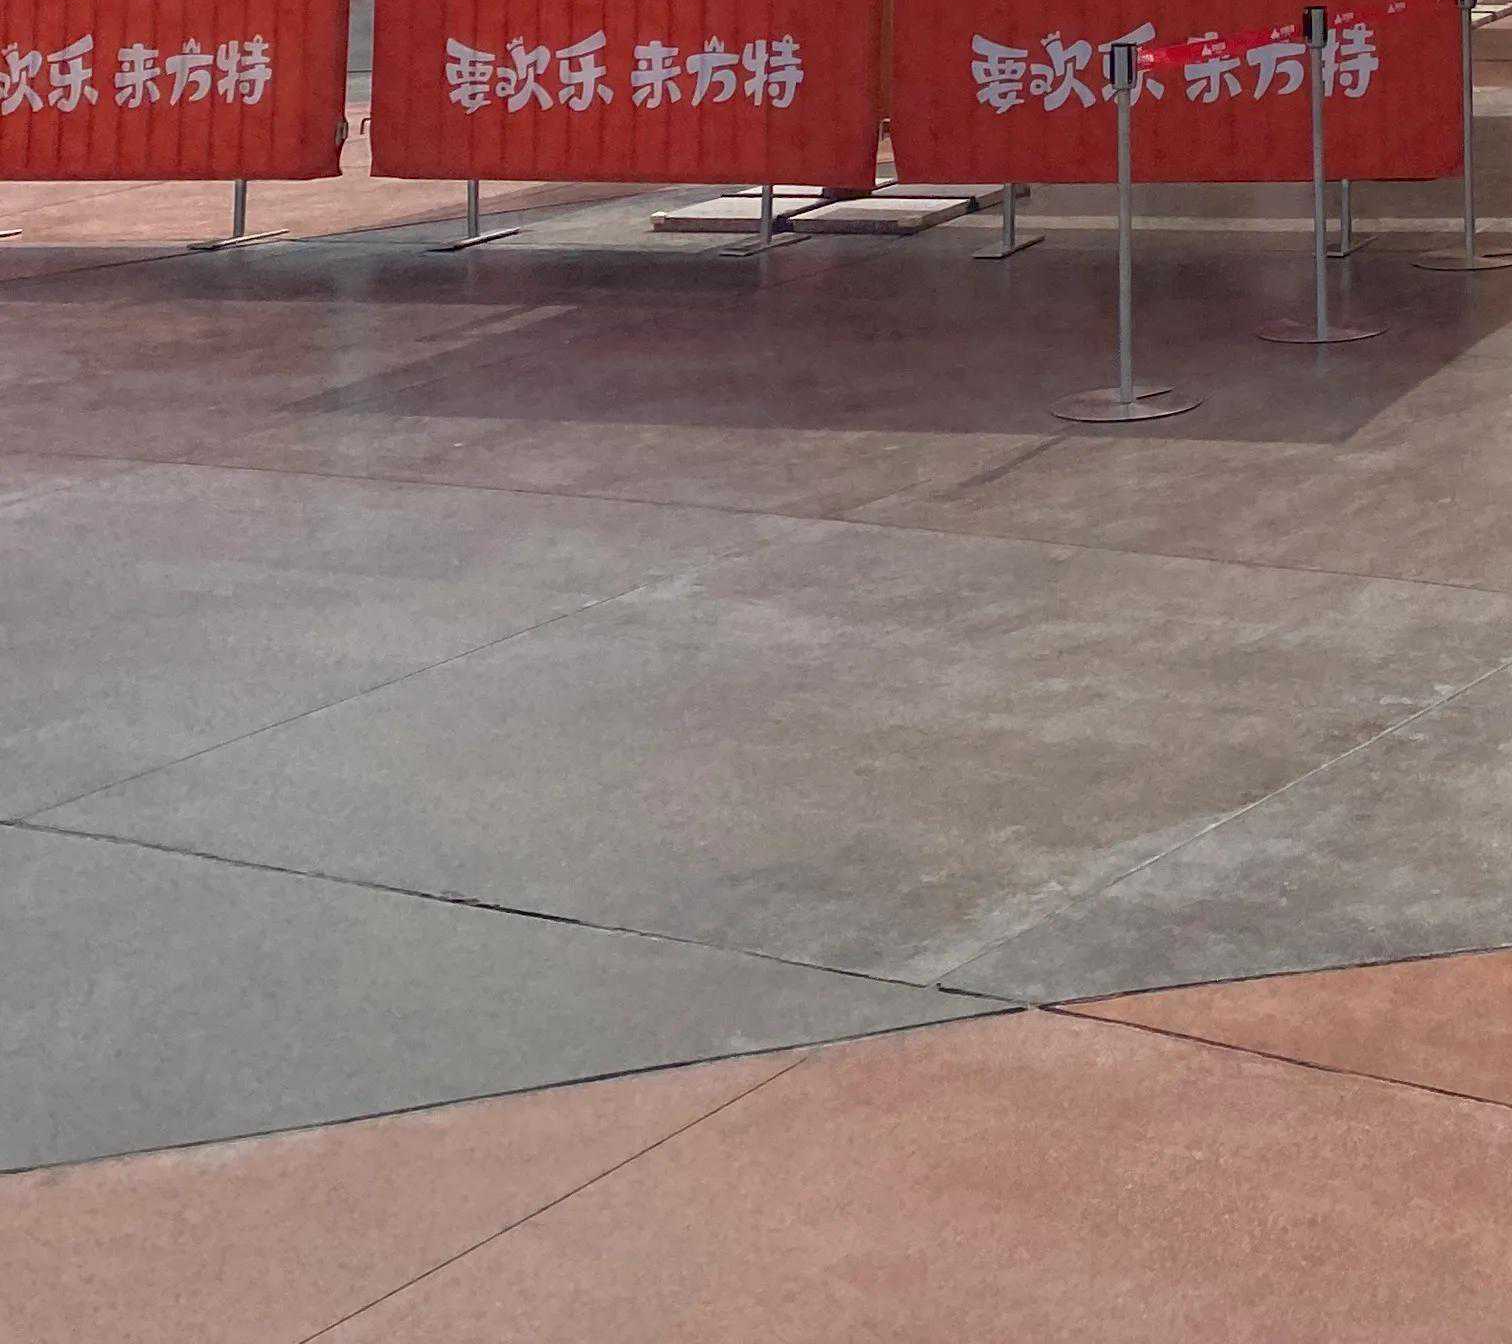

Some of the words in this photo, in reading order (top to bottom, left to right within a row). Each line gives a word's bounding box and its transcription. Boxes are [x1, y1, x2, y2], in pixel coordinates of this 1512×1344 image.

[114, 34, 273, 108] 来方特
[446, 28, 614, 114] 要欢乐
[631, 32, 804, 110] 来方特
